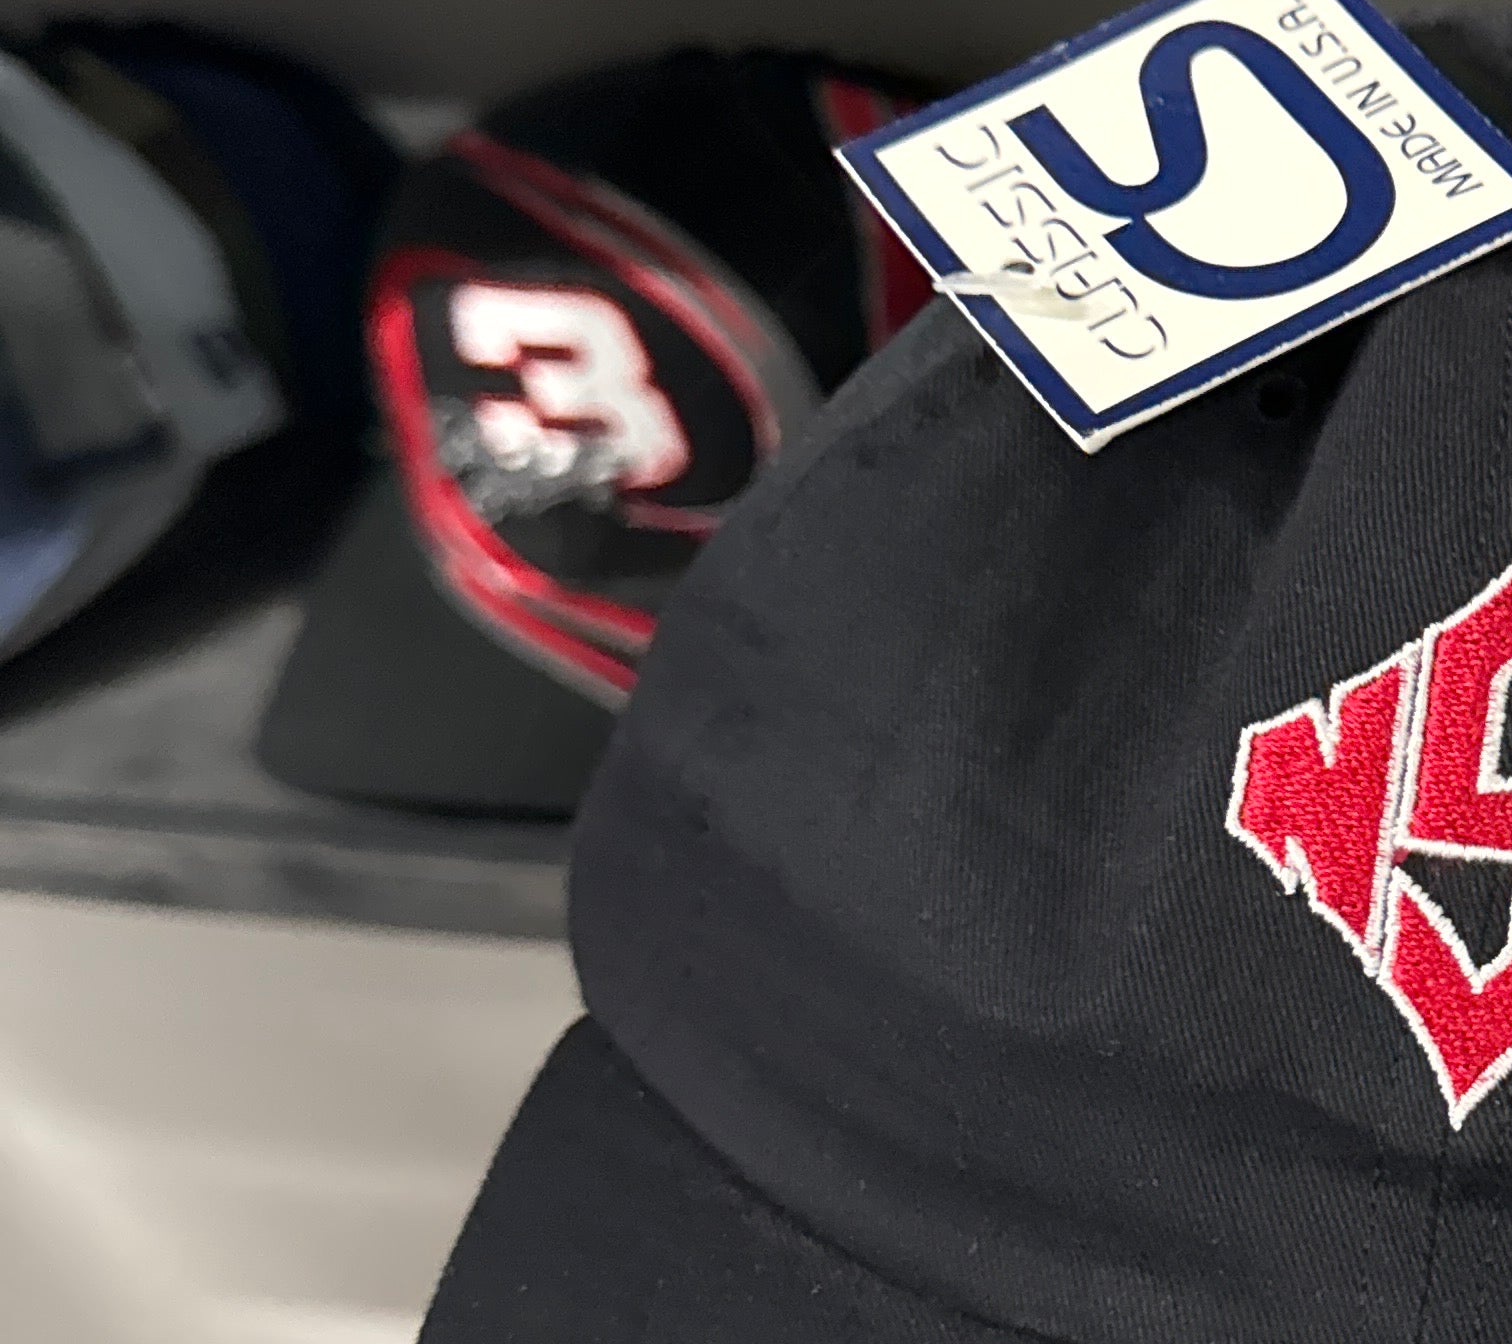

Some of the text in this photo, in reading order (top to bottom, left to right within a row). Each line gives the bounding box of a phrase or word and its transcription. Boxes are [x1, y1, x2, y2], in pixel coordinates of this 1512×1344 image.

[1345, 80, 1399, 119] IN
[1378, 112, 1485, 199] MADE
[933, 124, 1168, 360] CLASSIC
[449, 280, 695, 494] 3
